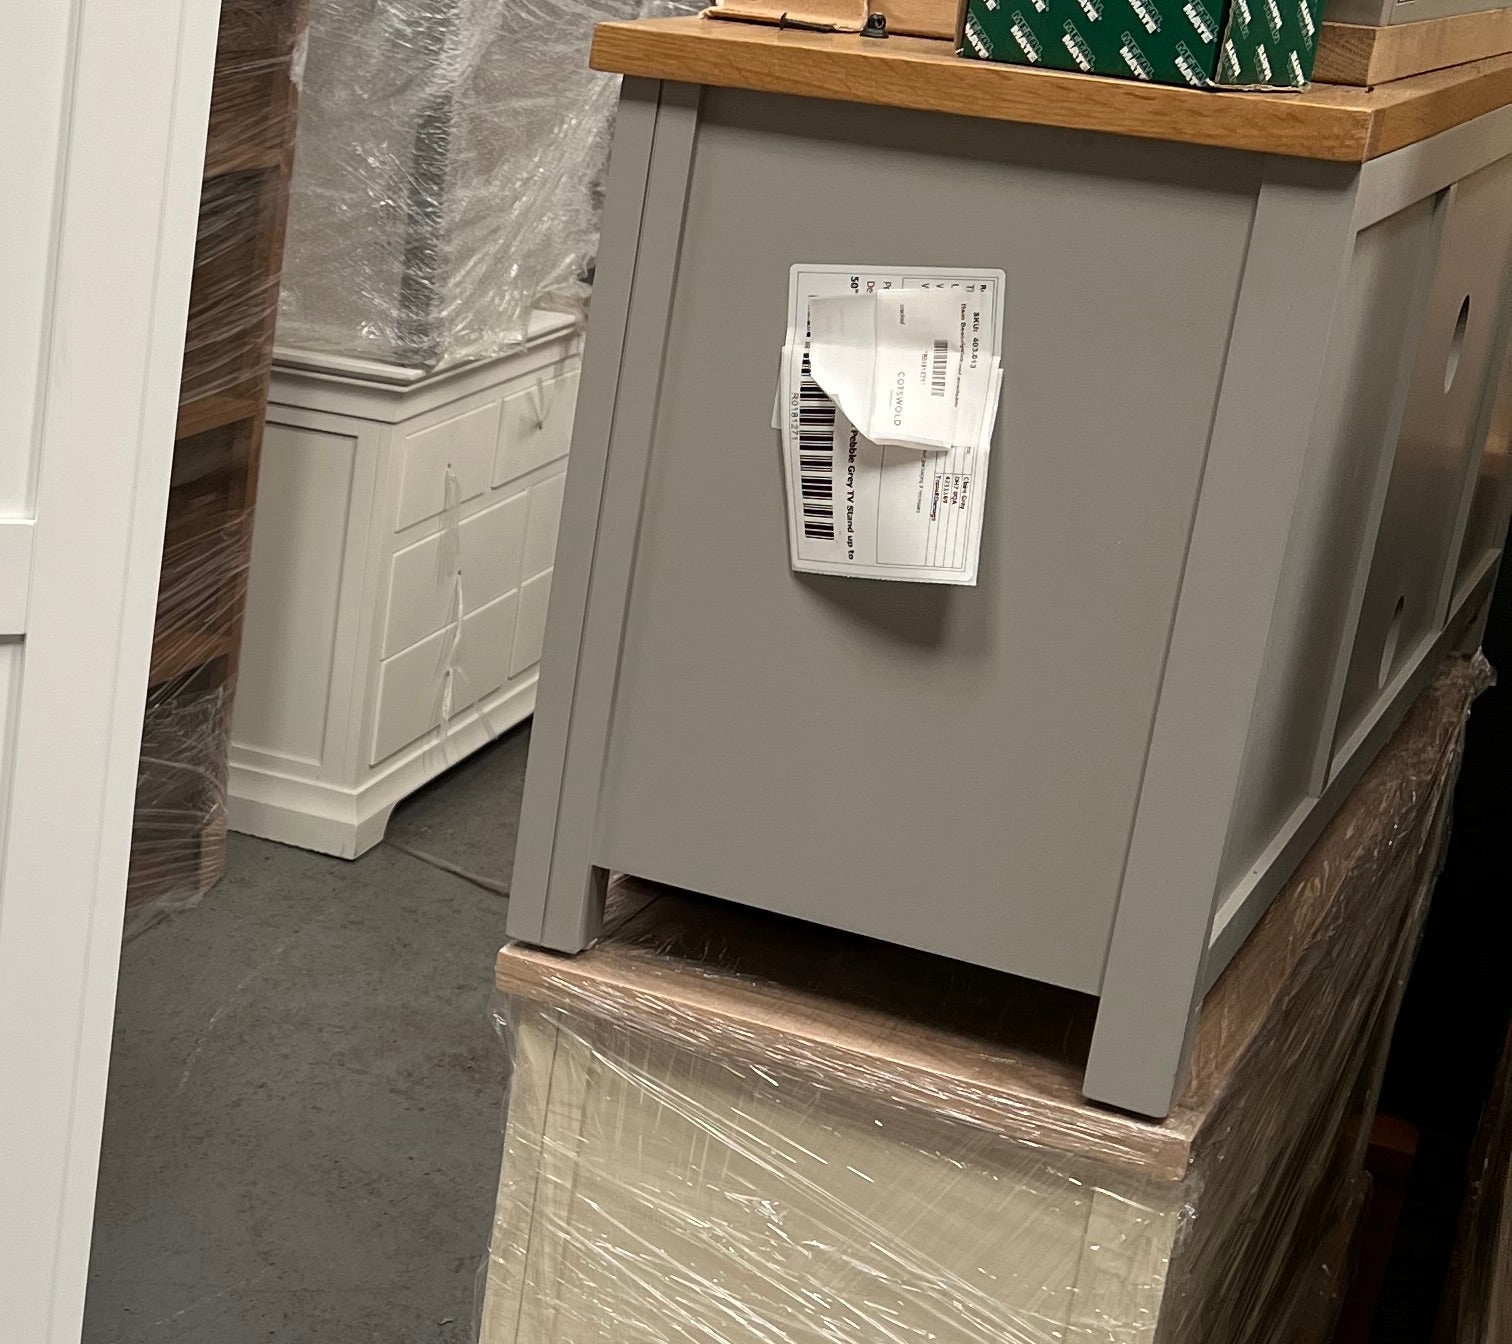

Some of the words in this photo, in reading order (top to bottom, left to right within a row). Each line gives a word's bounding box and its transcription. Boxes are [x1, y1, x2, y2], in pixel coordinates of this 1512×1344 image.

[965, 22, 989, 59] MATE
[1011, 10, 1043, 57] METAL
[1182, 4, 1213, 44] MATE
[1010, 24, 1038, 63] MATE
[1061, 33, 1091, 72] MATE
[1063, 19, 1096, 67] METAL
[1121, 30, 1155, 78] METAL
[1174, 55, 1201, 86] MAT
[850, 276, 859, 294] 50"
[790, 392, 800, 441] R0181271
[894, 371, 906, 427] COTSWOLD
[848, 430, 859, 464] Pebble
[845, 465, 855, 489] Grey
[846, 490, 854, 504] TV
[846, 505, 854, 533] Stand
[846, 535, 853, 548] up
[847, 550, 855, 560] to
